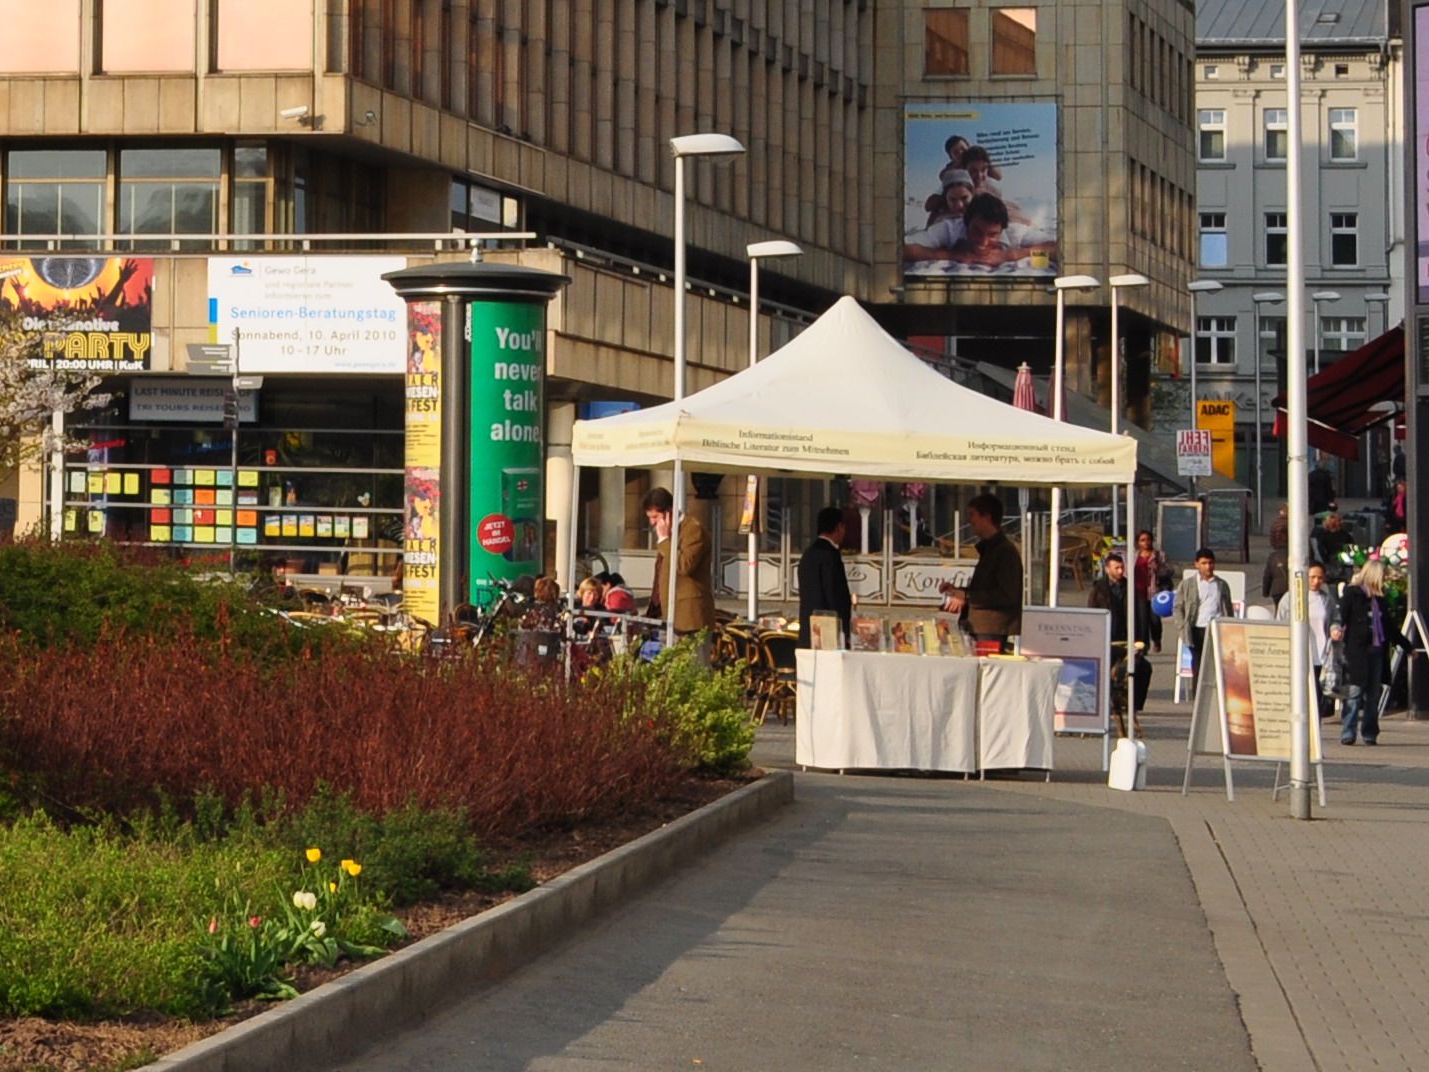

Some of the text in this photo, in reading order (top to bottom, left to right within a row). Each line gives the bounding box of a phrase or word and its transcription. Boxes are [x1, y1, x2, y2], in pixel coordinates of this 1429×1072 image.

[264, 265, 317, 275] Gewo Gera
[230, 306, 397, 322] Senioren-Beratungstag
[231, 330, 302, 342] Sonnabend,
[331, 330, 360, 343] April
[364, 330, 397, 341] 2010
[44, 332, 151, 359] PARTY
[324, 345, 347, 356] Uhr
[56, 359, 87, 370] 20:00
[88, 359, 113, 370] UHR
[134, 388, 157, 397] LAST
[160, 388, 196, 397] MINUTE
[503, 389, 538, 412] talk
[1201, 404, 1230, 417] ADAC
[743, 441, 780, 452] Literatur
[782, 444, 799, 453] zum
[481, 536, 512, 547] HANDEL
